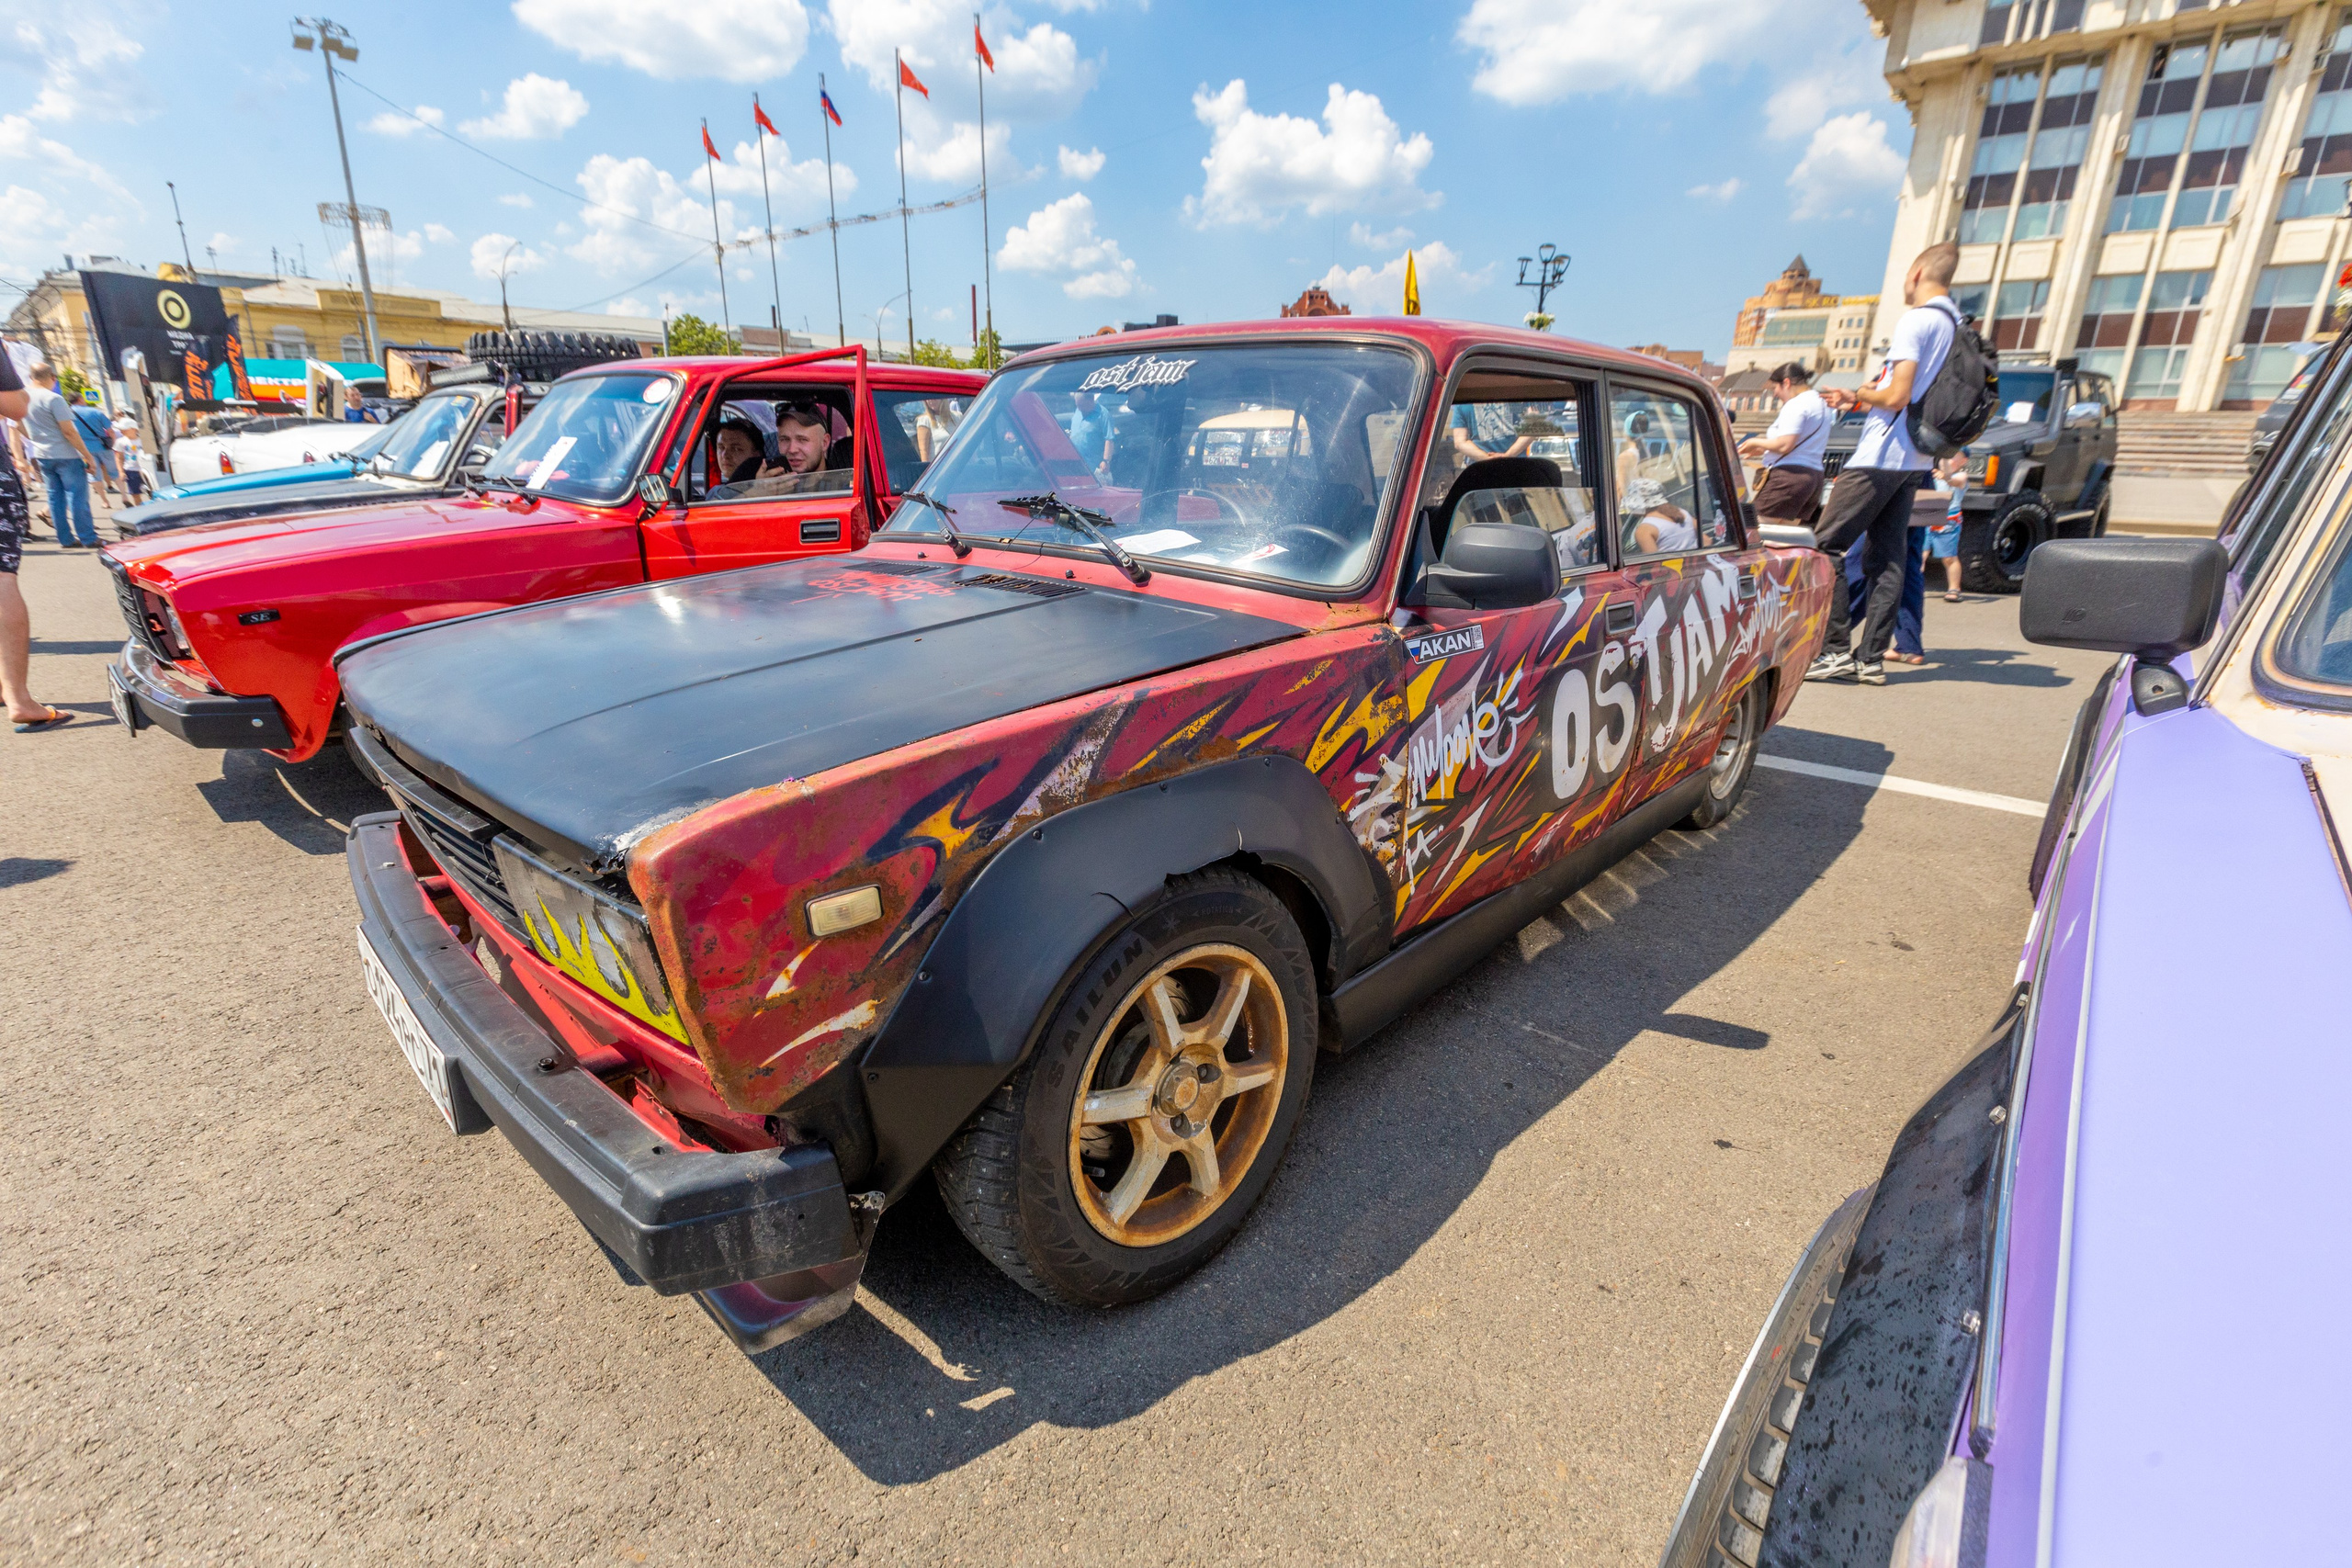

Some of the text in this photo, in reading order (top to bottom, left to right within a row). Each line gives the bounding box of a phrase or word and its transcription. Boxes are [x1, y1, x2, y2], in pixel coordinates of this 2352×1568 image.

[250, 612, 271, 623] SE
[1419, 631, 1472, 660] AKAN
[1047, 937, 1145, 1089] SAILUN
